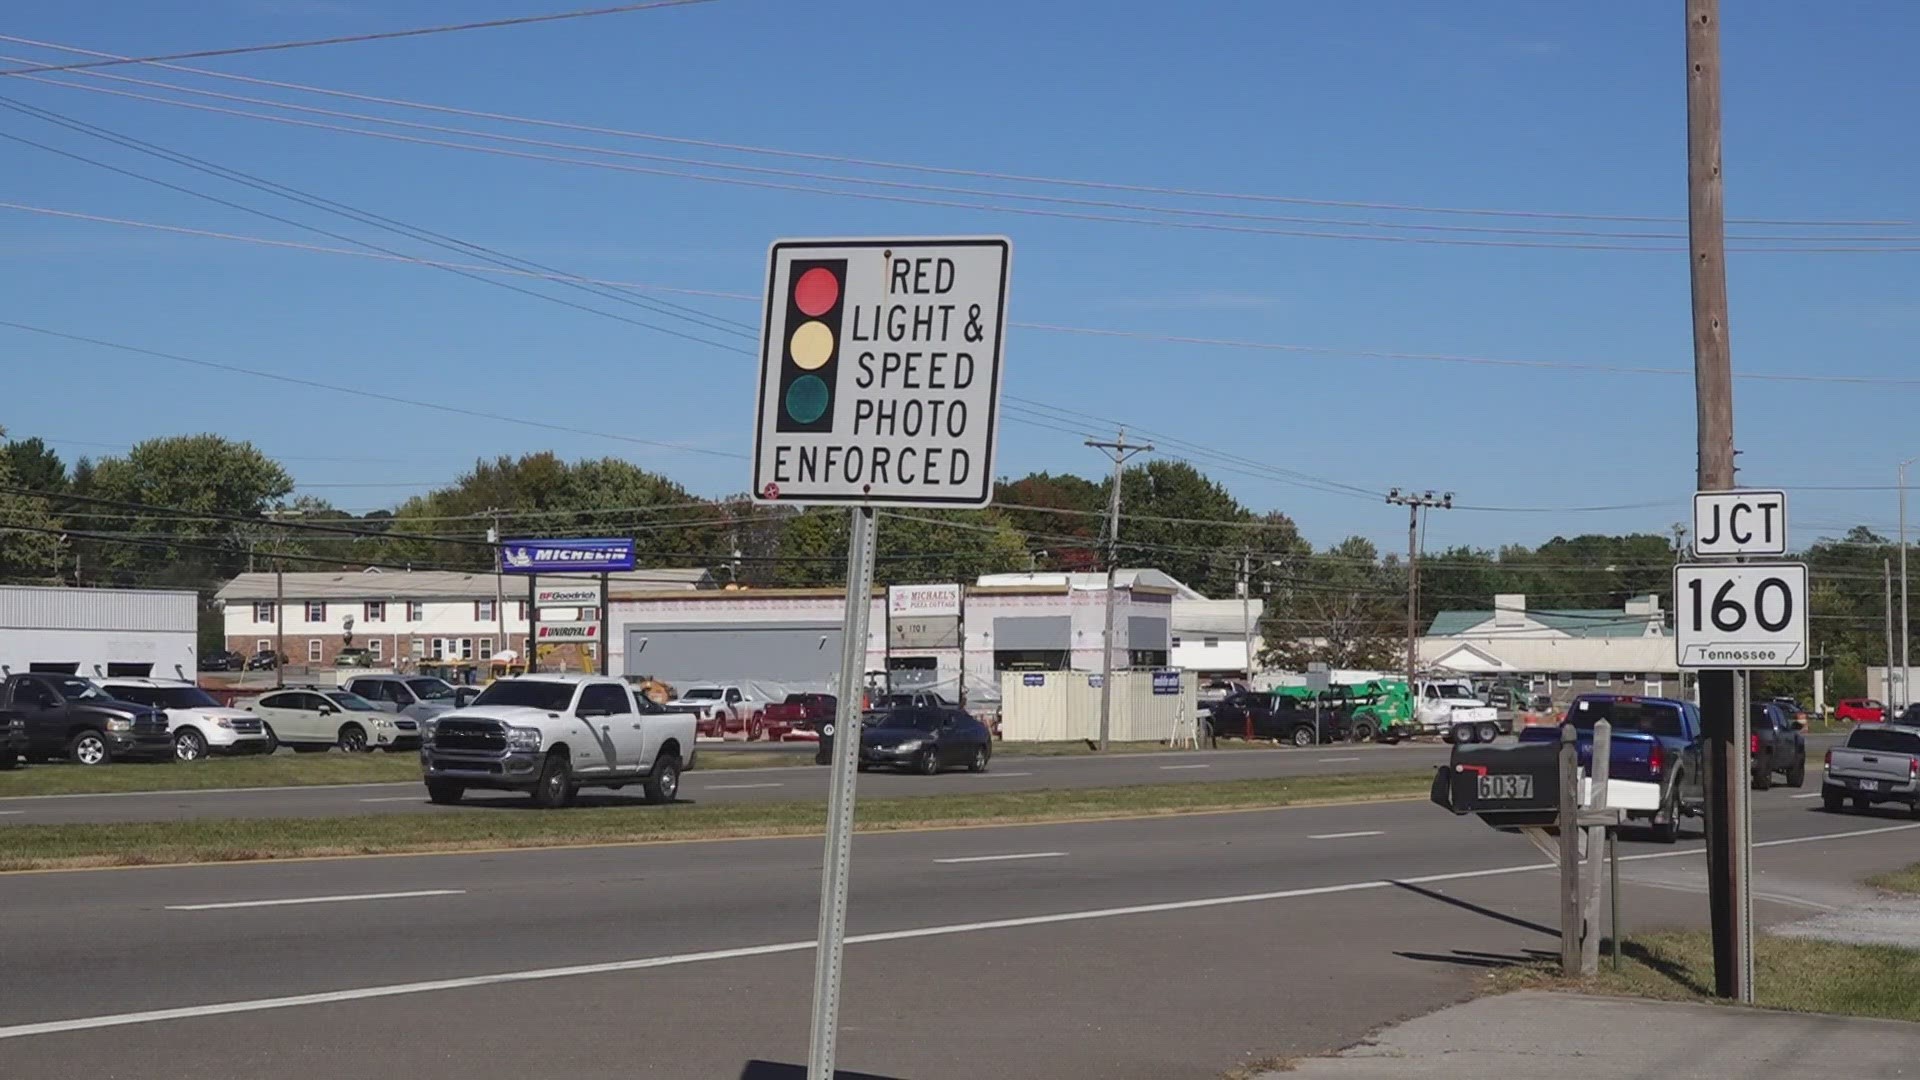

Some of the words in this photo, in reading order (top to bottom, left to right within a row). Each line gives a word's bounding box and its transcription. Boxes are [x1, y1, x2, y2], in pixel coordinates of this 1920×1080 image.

[890, 258, 955, 294] RED
[852, 304, 955, 342] LIGHT
[963, 303, 984, 343] &
[855, 351, 974, 389] SPEED
[853, 399, 967, 437] PHOTO
[774, 445, 969, 485] ENFORCED
[1701, 502, 1778, 545] JCT
[535, 548, 628, 561] MICHELIN
[538, 591, 596, 600] BFGoodrich
[911, 591, 956, 601] MICHAEL'S
[1688, 577, 1792, 632] 160
[547, 626, 586, 637] UNIROYAL
[1698, 648, 1777, 660] Tennessee
[1479, 776, 1531, 798] 6037
